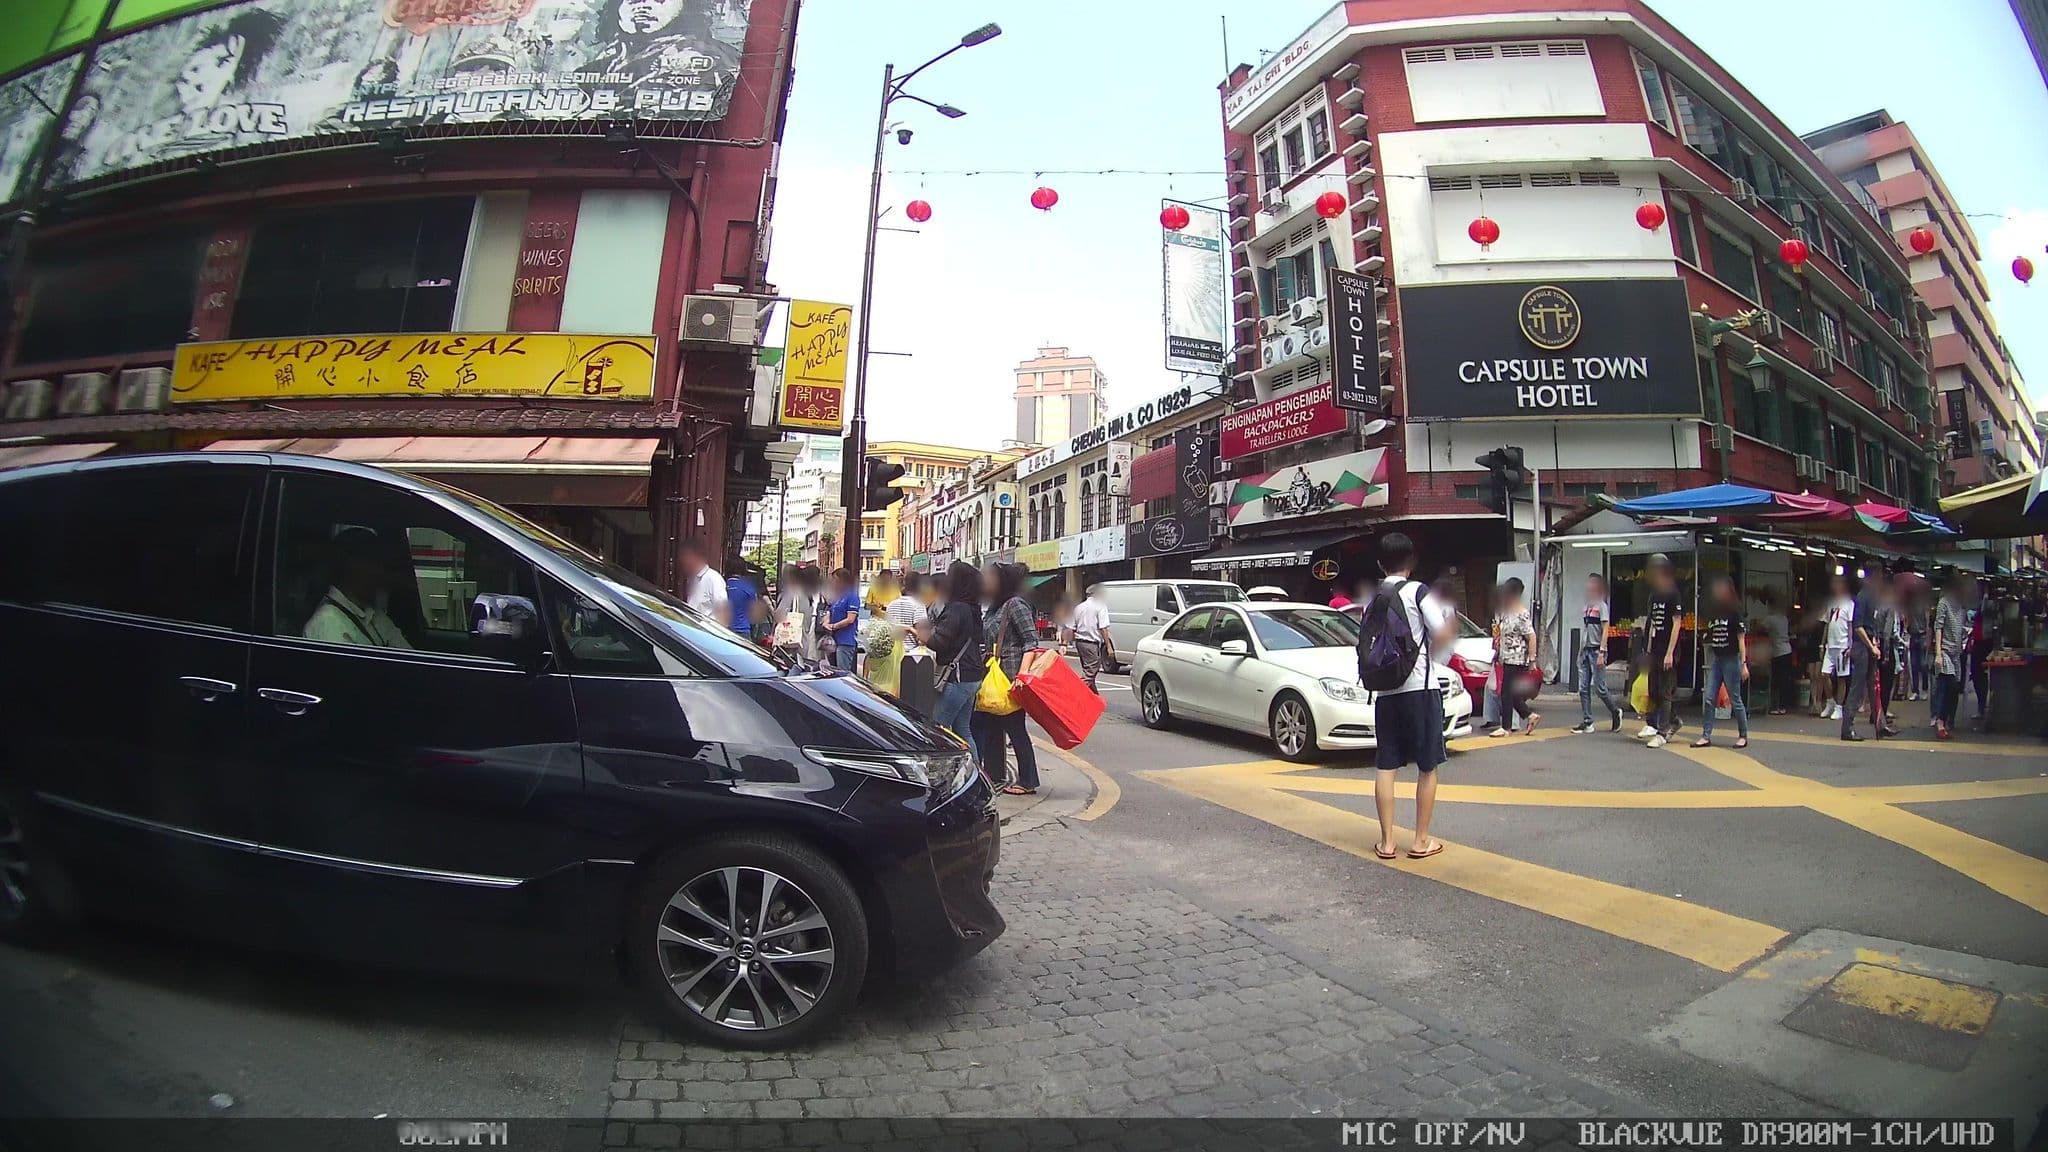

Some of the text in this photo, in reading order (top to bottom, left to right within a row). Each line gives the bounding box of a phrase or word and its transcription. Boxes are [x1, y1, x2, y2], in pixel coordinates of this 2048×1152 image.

[666, 76, 701, 85] ZONE
[1227, 96, 1243, 114] YAP
[1247, 81, 1262, 97] TAI
[1265, 64, 1281, 83] CHI
[342, 88, 715, 122] RESTAURANT & PUB
[183, 102, 289, 138] LOVE
[522, 249, 566, 268] WINES
[1337, 275, 1370, 291] CAPSULE
[1342, 284, 1366, 297] TOWN
[807, 312, 836, 325] KAFE
[245, 336, 527, 365] HAPPY MEAL
[791, 321, 848, 360] HAPPY
[1348, 296, 1366, 391] HOTEL
[189, 351, 226, 372] KAFE
[802, 342, 843, 377] MEAL
[1458, 356, 1649, 384] CAPSULE TOWN
[274, 360, 478, 391] 開心小食店
[795, 386, 835, 403] 開心
[1516, 384, 1598, 408] HOTEL
[785, 403, 839, 420] 小食店
[1071, 385, 1192, 454] CHEONG HIN & CO (1923)
[1222, 385, 1332, 433] PENGINAPAN PENGEMBAR
[1244, 408, 1315, 440] BACKPACKERS
[1249, 430, 1287, 449] TRAVELLERS
